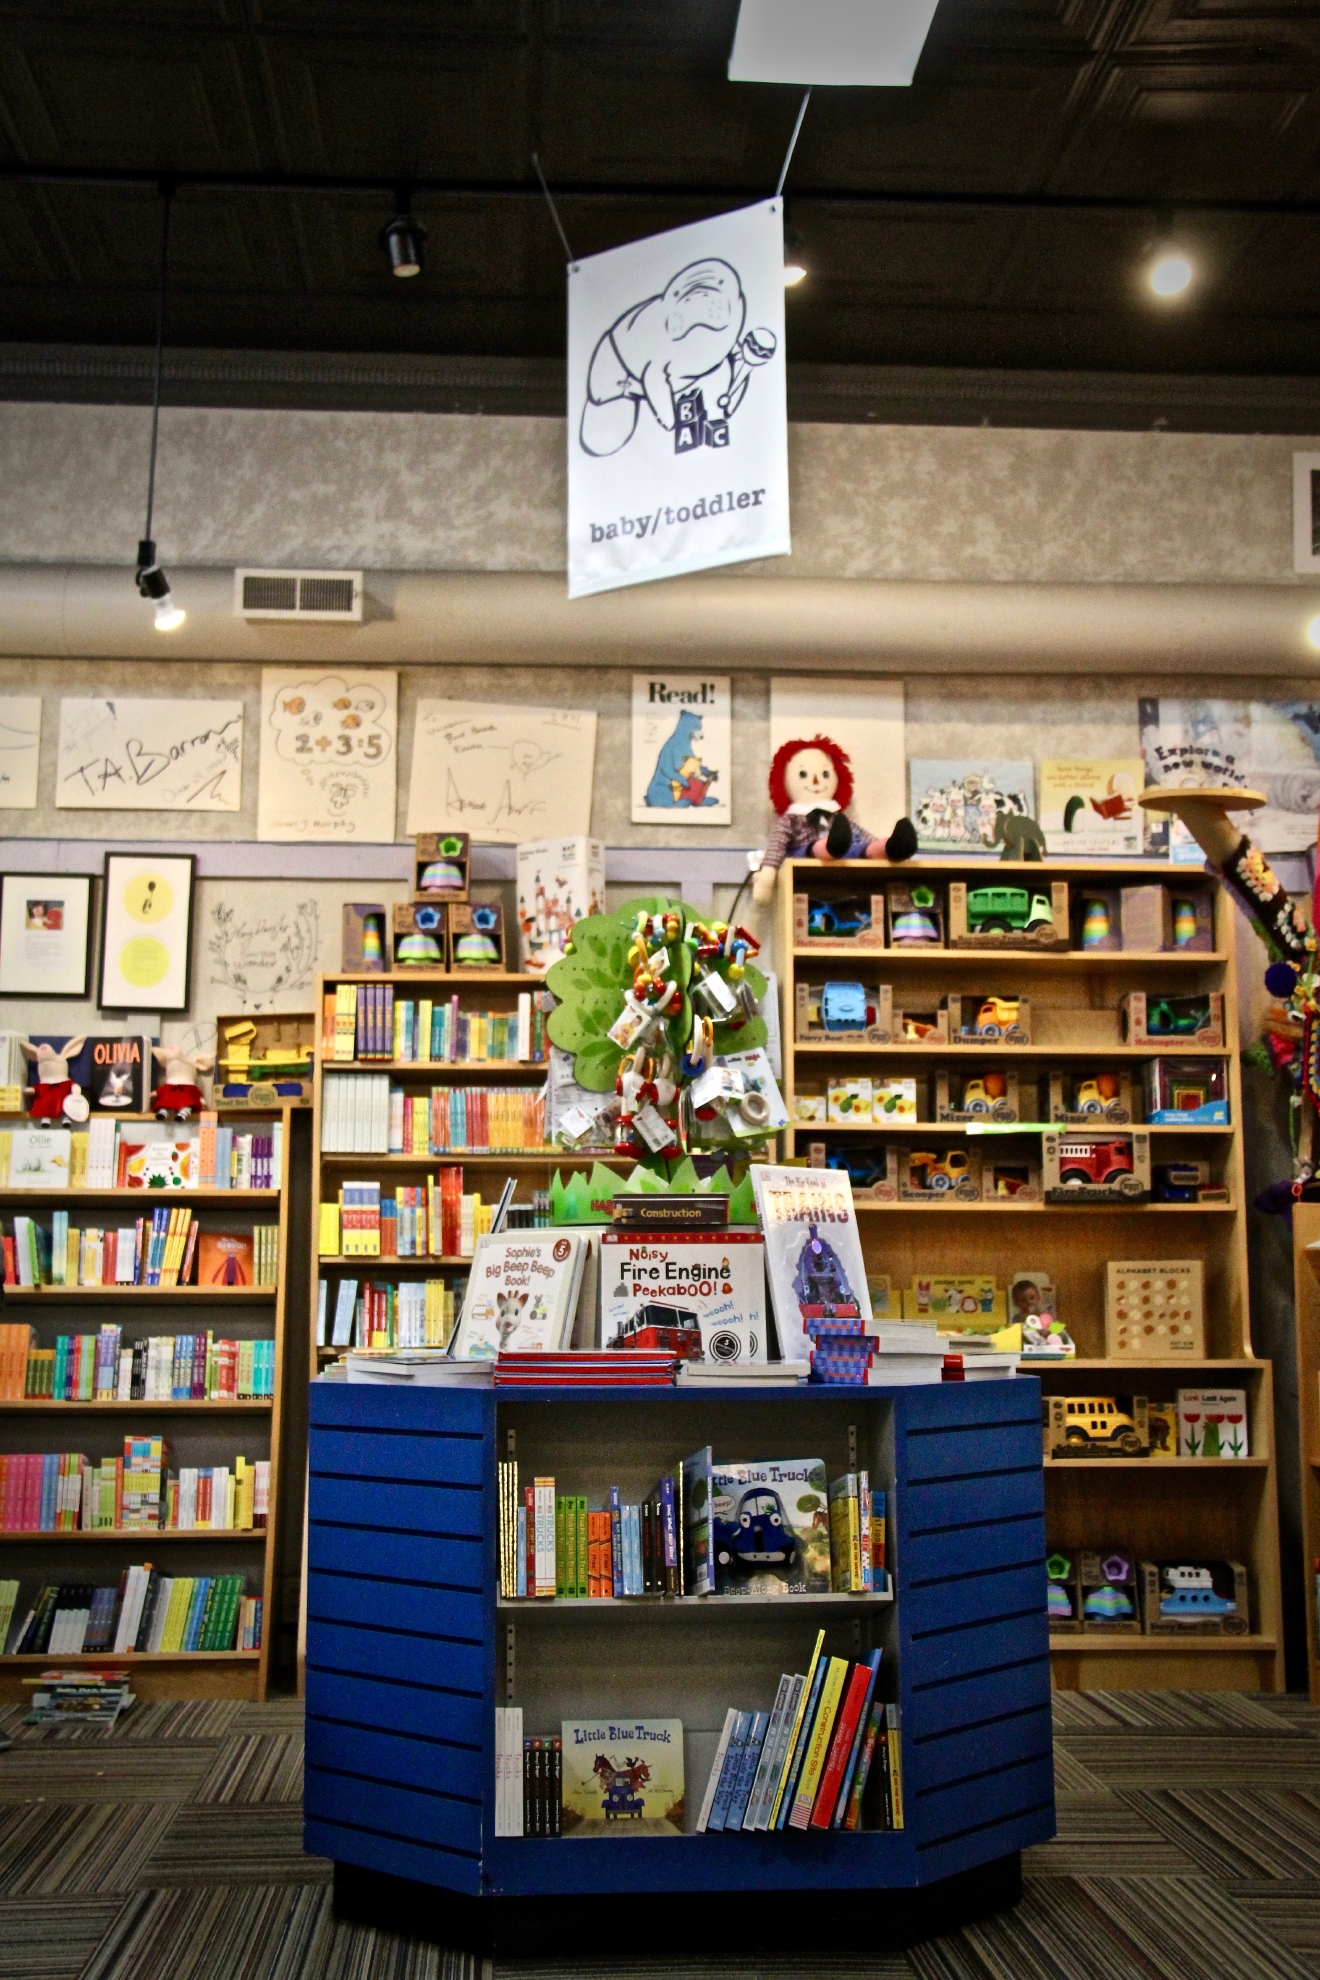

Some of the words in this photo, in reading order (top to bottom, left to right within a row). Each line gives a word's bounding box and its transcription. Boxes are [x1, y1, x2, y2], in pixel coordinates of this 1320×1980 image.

[679, 402, 693, 422] B
[679, 430, 692, 447] A
[714, 428, 726, 446] C
[590, 487, 767, 544] baby/toddler
[648, 681, 716, 705] Read!
[1155, 745, 1221, 761] Explore
[1225, 754, 1236, 765] a
[1163, 759, 1194, 773] new
[1201, 760, 1245, 782] world
[953, 1035, 999, 1045] Dumper
[94, 1042, 141, 1065] OLIVIA
[939, 1113, 975, 1123] Mixer
[1054, 1113, 1089, 1123] Mixer
[29, 1135, 51, 1145] Ollie
[785, 1176, 795, 1186] The
[640, 1208, 702, 1218] Construction
[769, 1190, 849, 1223] TRAINS
[505, 1246, 542, 1260] Sophie's
[629, 1248, 669, 1262] Noisy
[486, 1265, 501, 1278] Big
[503, 1260, 529, 1274] Beep
[531, 1260, 555, 1279] Beep
[620, 1262, 660, 1280] Fire
[665, 1262, 731, 1282] Engine
[505, 1275, 530, 1286] Book!
[712, 1472, 734, 1486] ttle
[737, 1469, 768, 1485] Blue
[714, 1499, 733, 1508] beep!
[536, 1514, 544, 1553] TRUCKS
[546, 1514, 554, 1553] TRUCKS
[724, 1583, 779, 1595] Beep-Along
[782, 1582, 807, 1593] Book
[574, 1729, 606, 1744] Little
[609, 1726, 634, 1740] Blue
[635, 1726, 671, 1743] Truck
[812, 1705, 831, 1758] Construction
[766, 1736, 774, 1747] THE
[779, 1736, 787, 1747] THE
[731, 1752, 741, 1771] Little
[762, 1747, 771, 1762] MOVE
[775, 1748, 783, 1762] MOVE
[711, 1752, 724, 1777] Trucks
[722, 1754, 733, 1775] Leads
[789, 1745, 803, 1782] VEHICLES
[807, 1759, 818, 1776] Site
[719, 1776, 727, 1788] the
[726, 1772, 736, 1789] Blue
[714, 1789, 724, 1805] Way
[720, 1790, 731, 1811] Truck
[731, 1789, 740, 1804] Way
